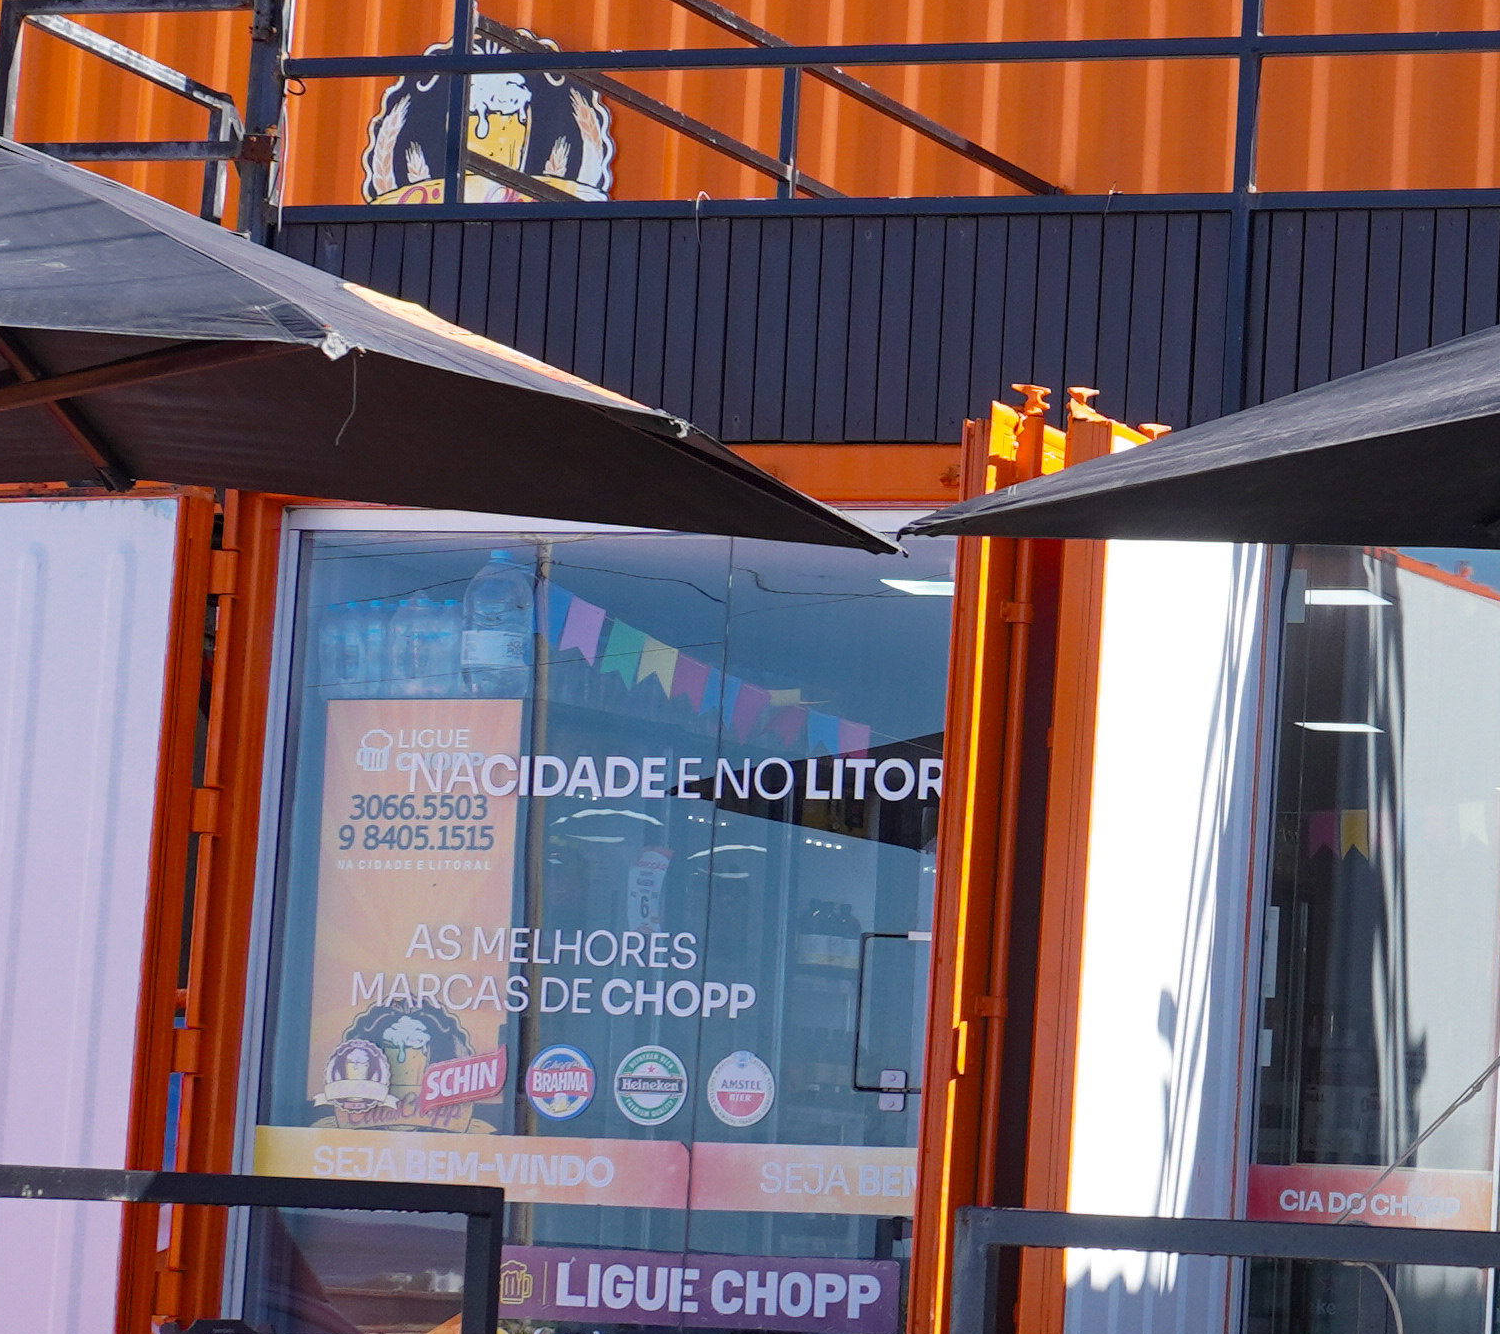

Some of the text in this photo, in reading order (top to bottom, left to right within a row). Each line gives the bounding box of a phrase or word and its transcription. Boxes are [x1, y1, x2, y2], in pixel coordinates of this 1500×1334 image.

[398, 729, 470, 749] LIGUE
[409, 752, 480, 795] NA
[481, 754, 666, 802] CIDADE
[680, 759, 700, 799] E
[715, 756, 793, 801] NO
[349, 794, 488, 820] 3066.5503
[338, 825, 495, 851] 9 8405.1515
[428, 859, 492, 871] LITORAL
[406, 924, 698, 971] AS MELHORES
[350, 971, 757, 1019] MARCAS DE CHOPP
[425, 1058, 499, 1101] SCHIN
[532, 1071, 589, 1093] BRAHMA
[621, 1078, 680, 1093] Heineken
[720, 1078, 762, 1091] AMSTEL
[312, 1145, 615, 1188] SEJA BEM-VINDO
[760, 1161, 850, 1196] SEJA
[1280, 1189, 1461, 1218] CIA DO CHOPP
[556, 1261, 881, 1320] LIGUE CHOPP
